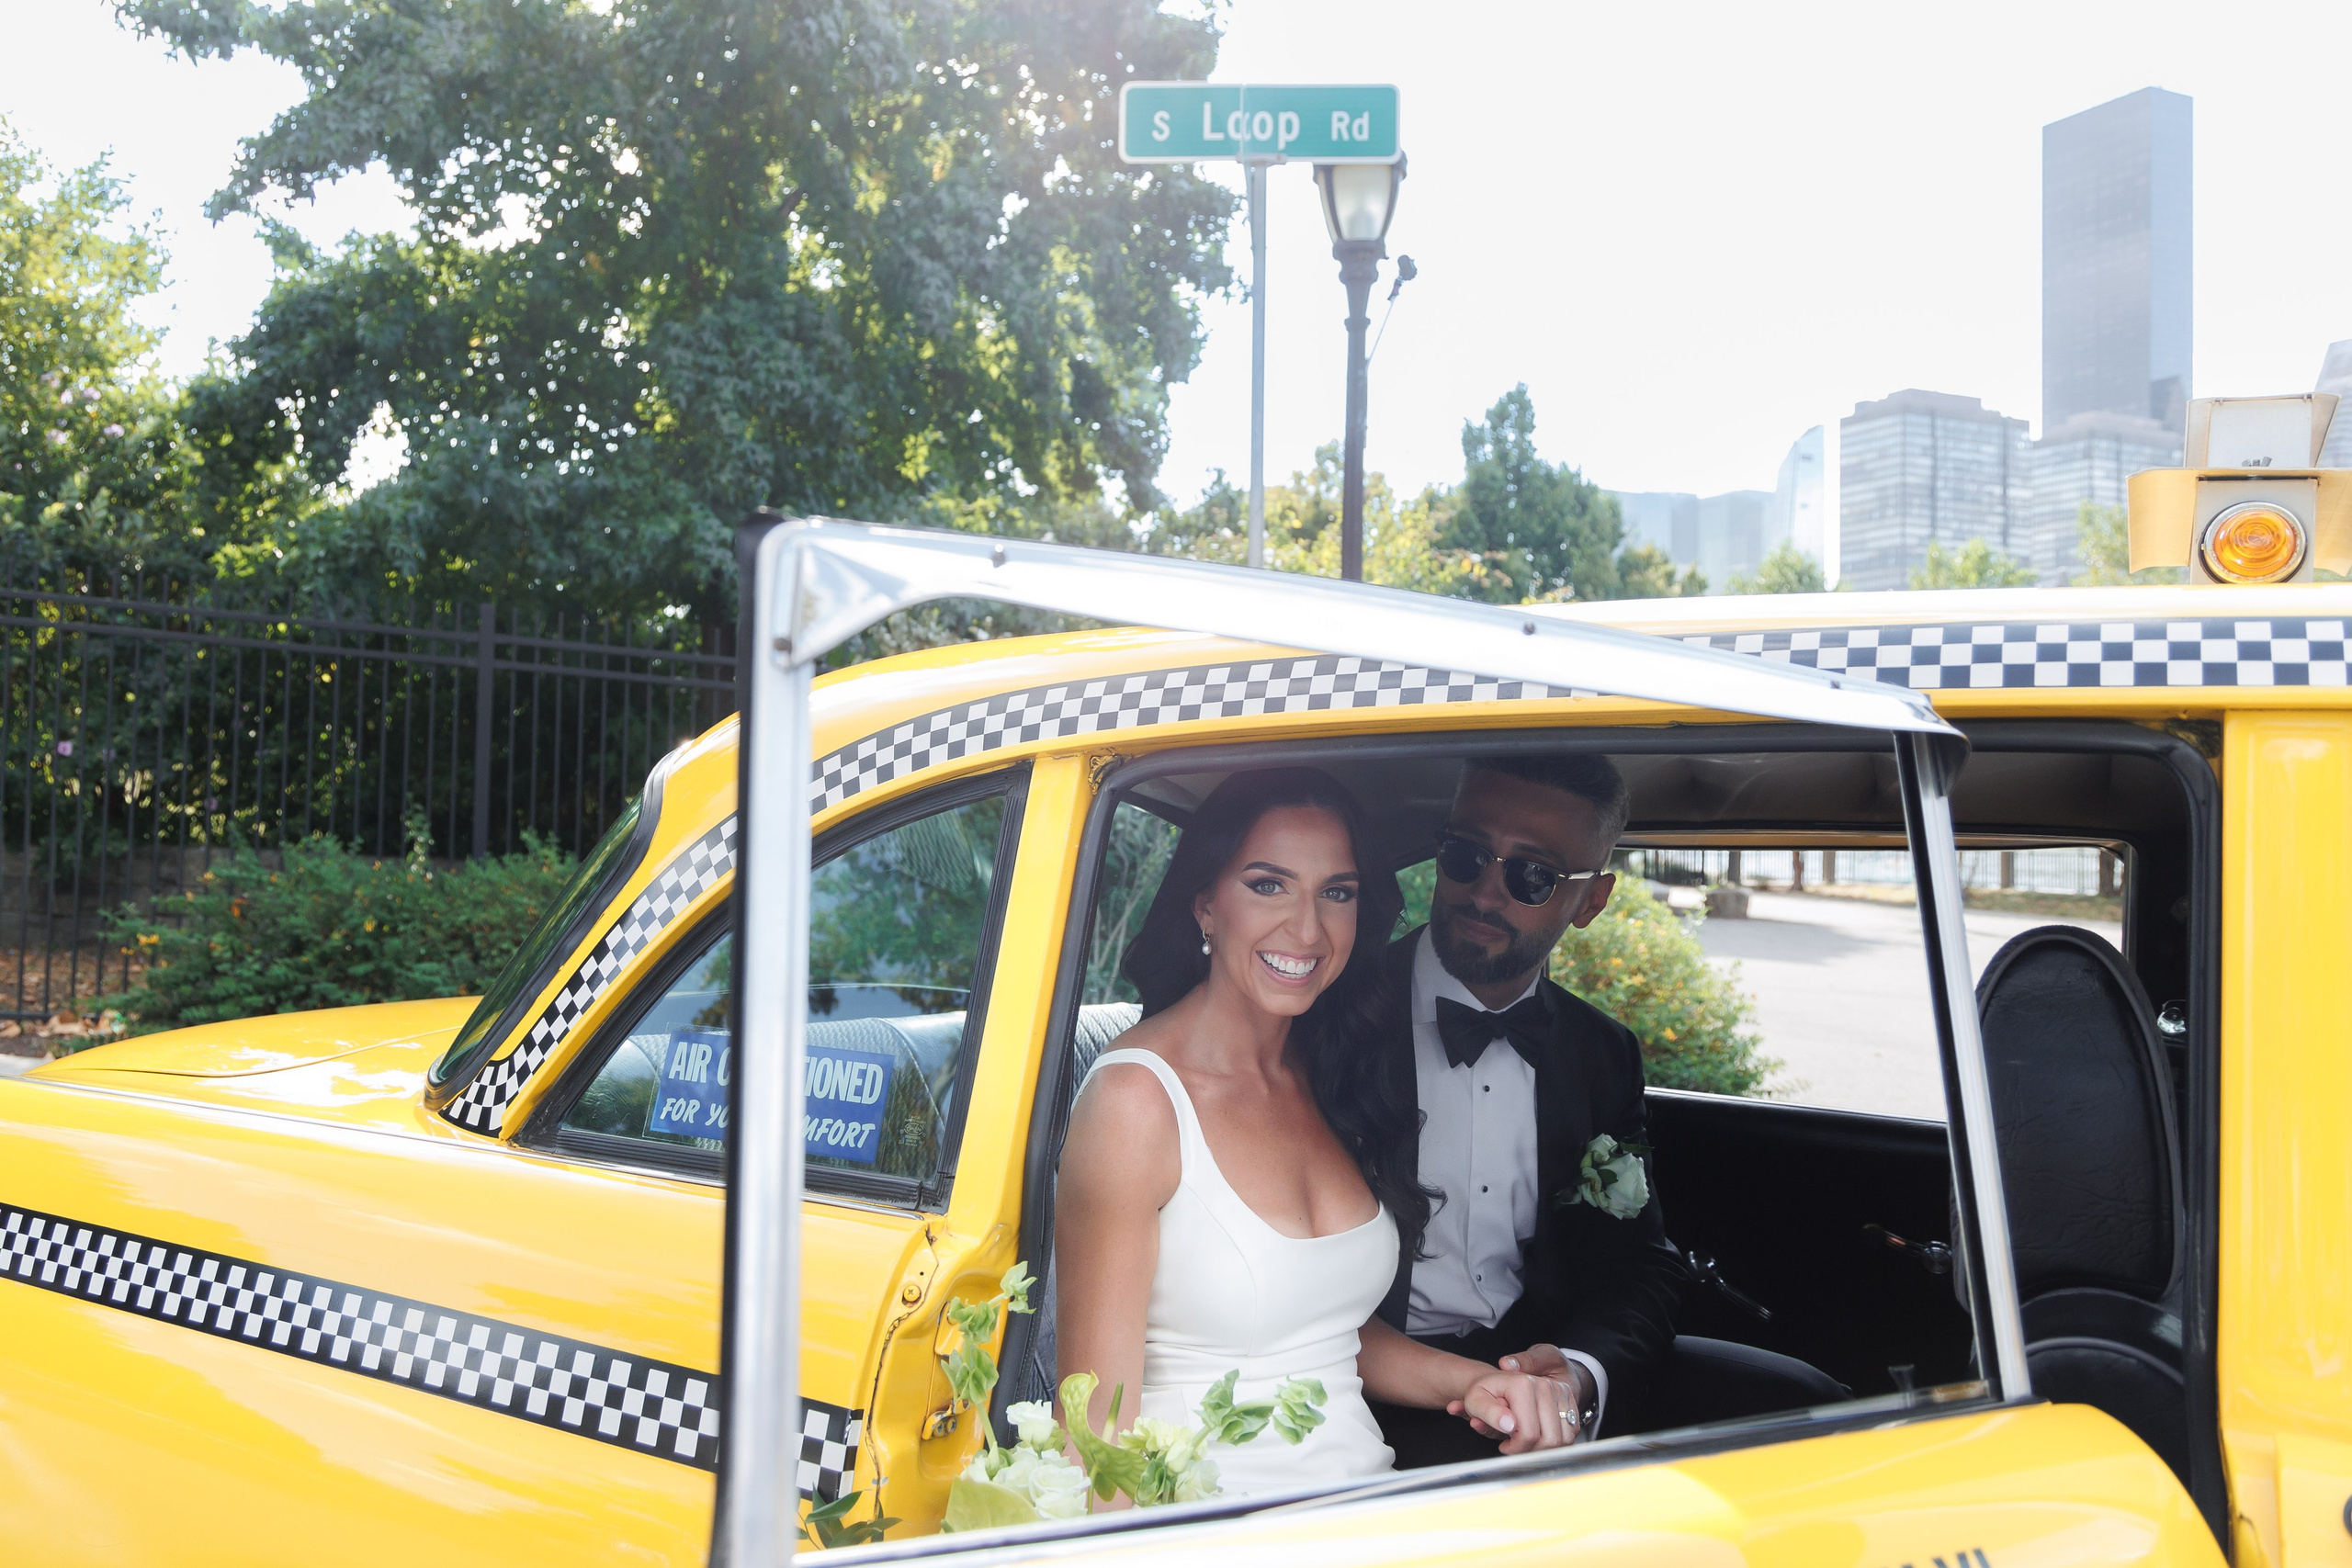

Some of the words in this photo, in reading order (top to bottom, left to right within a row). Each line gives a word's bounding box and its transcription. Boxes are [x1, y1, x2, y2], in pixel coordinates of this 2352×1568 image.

[1151, 110, 1170, 141] S
[1203, 101, 1300, 151] Loop
[1331, 110, 1370, 141] Rd
[668, 1041, 712, 1084] AIR
[660, 1098, 701, 1123] FOR
[801, 1114, 876, 1149] MFORT
